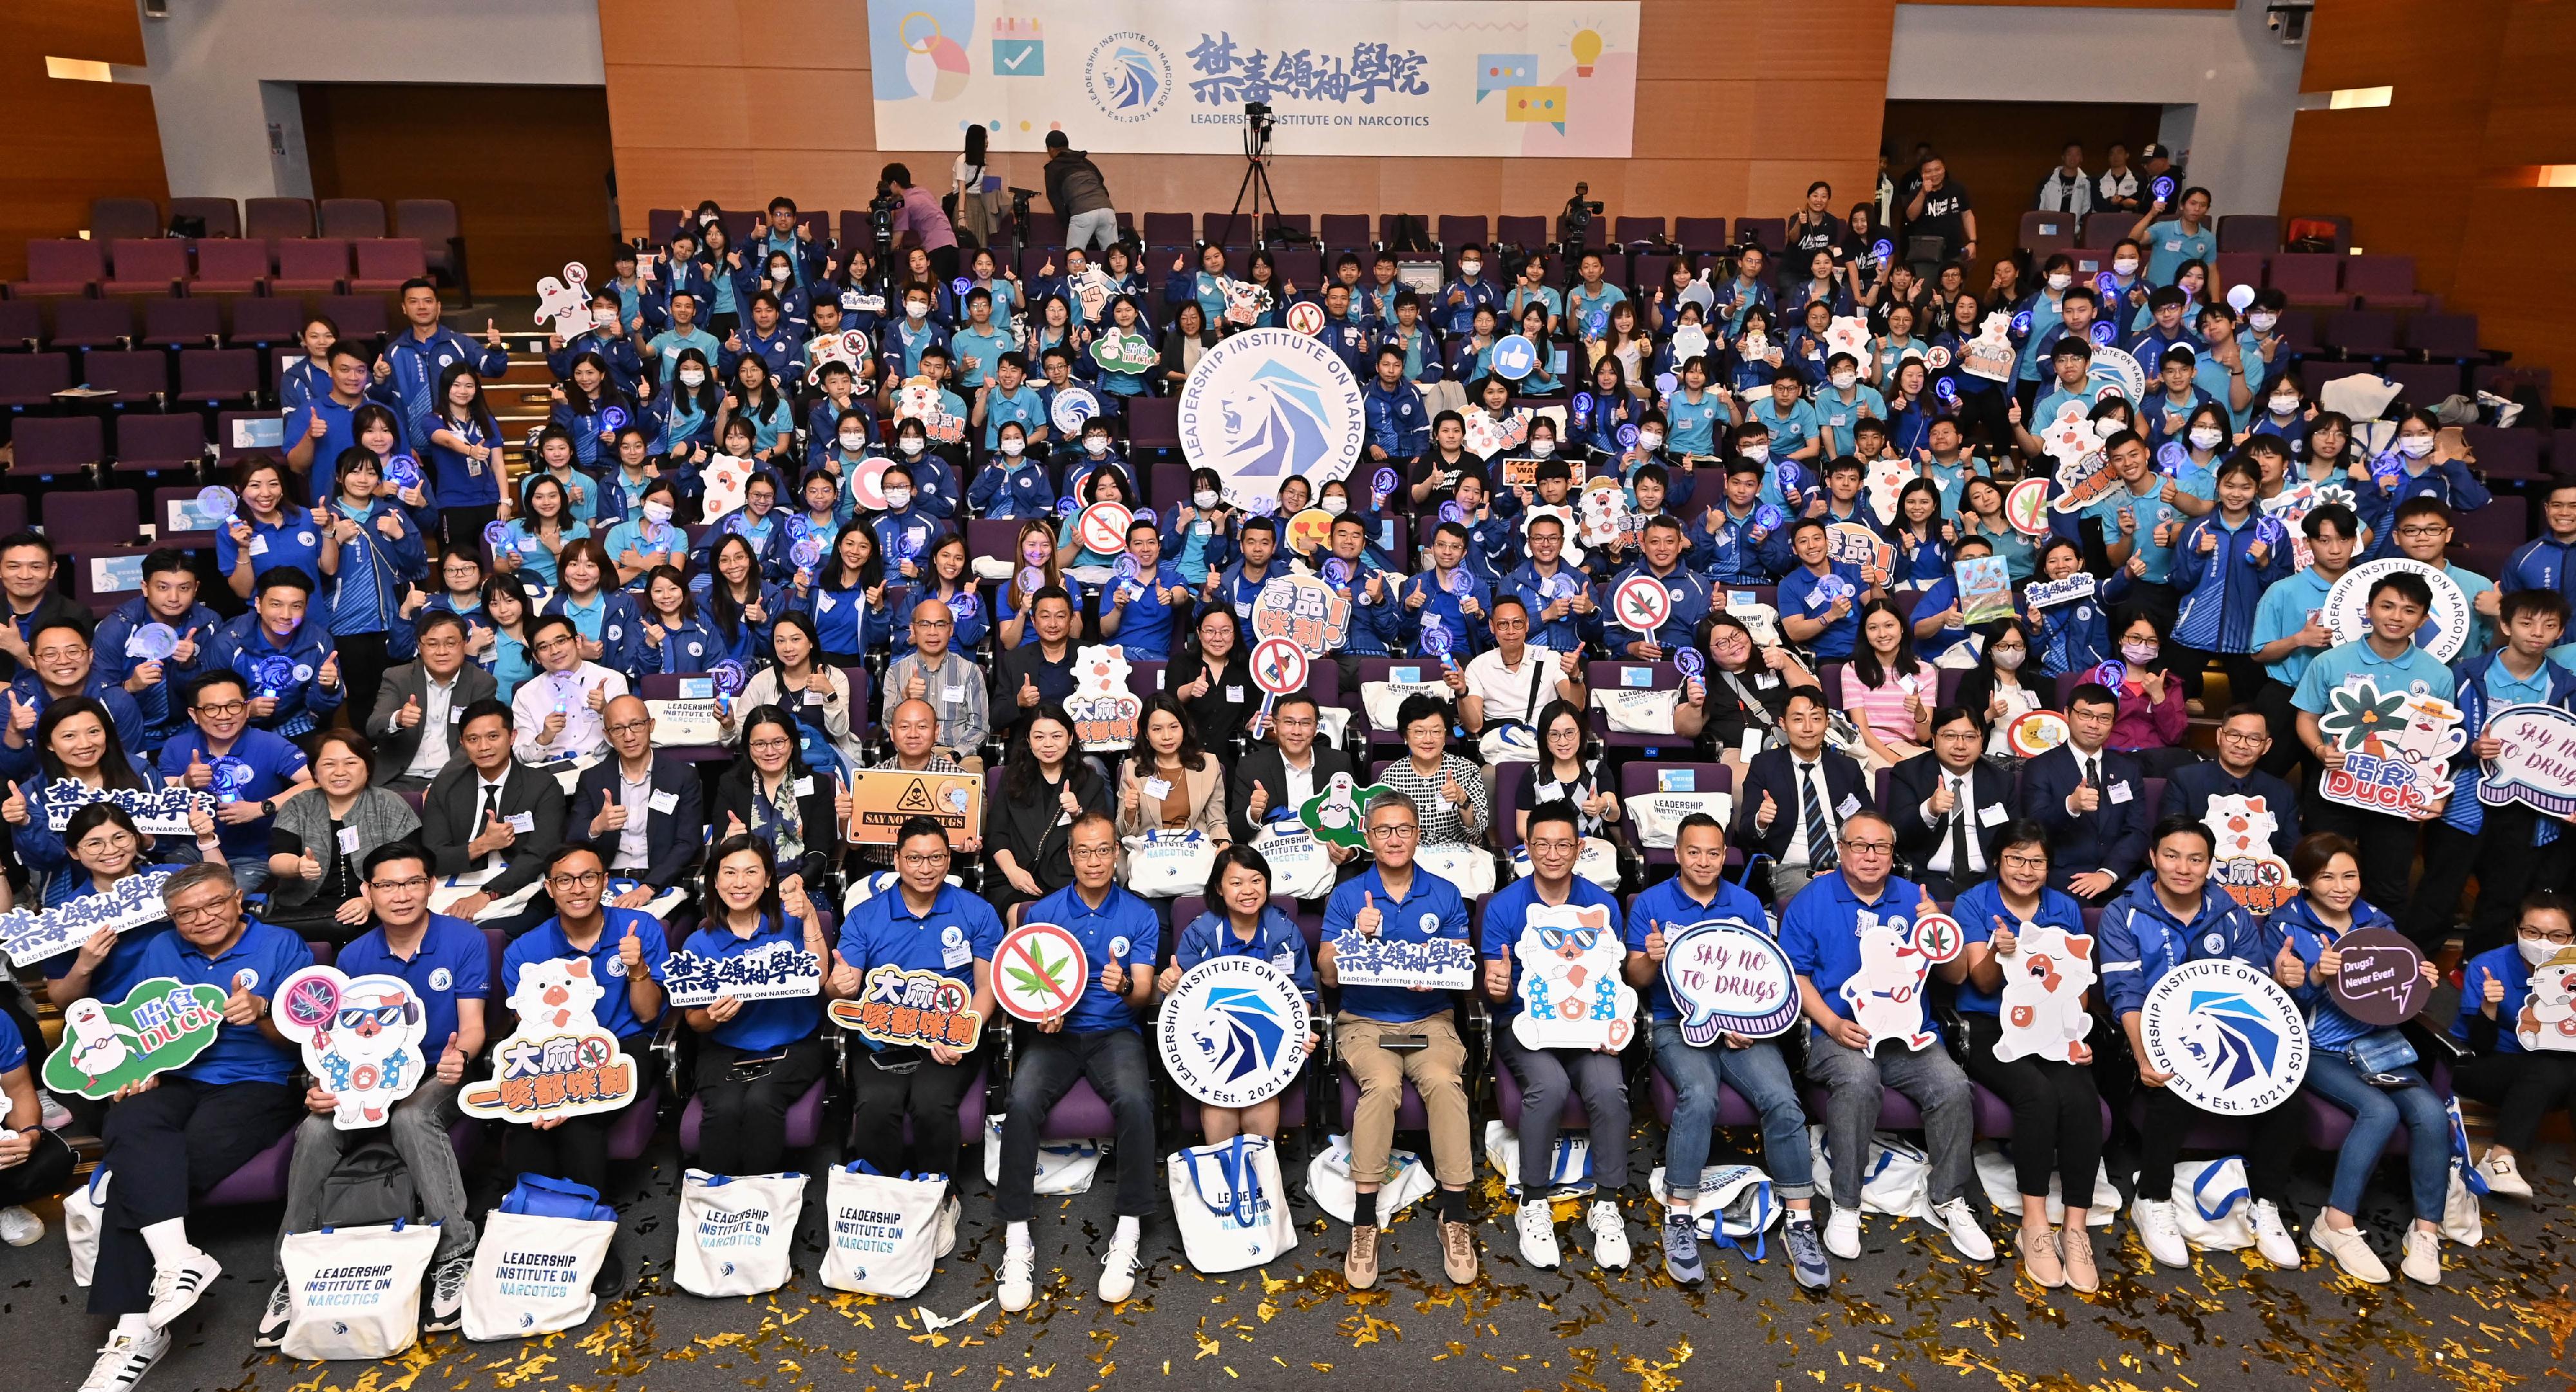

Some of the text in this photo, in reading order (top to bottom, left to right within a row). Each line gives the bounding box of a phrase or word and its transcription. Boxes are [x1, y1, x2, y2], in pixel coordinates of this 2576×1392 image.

[1085, 32, 1172, 107] LEADERSHIP INSTITUTE ON NARCOTICS
[1186, 30, 1430, 106] 禁毒領袖學院
[1334, 115, 1352, 125] ON
[1358, 115, 1430, 126] NARCOTICS
[1123, 353, 1151, 365] DUCK
[2121, 355, 2132, 365] ON
[2132, 366, 2143, 400] NARCOT
[1185, 333, 1362, 489] LEADERSHIP INSTITUTE ON NARCOTICS
[1264, 578, 1323, 616] 毒品
[2330, 562, 2465, 658] EADERSHIP INSTITUTE ON NARCOTICS
[1070, 697, 1116, 720] 大麻
[2515, 722, 2576, 760] SAY N
[2345, 755, 2415, 787] 唔食
[2499, 738, 2576, 787] TO DRUG
[2327, 769, 2421, 810] Duck
[1655, 800, 1703, 809] LEADERSHIP
[866, 813, 886, 824] SAY
[888, 814, 904, 825] NO
[935, 816, 963, 827] RUGS
[1147, 849, 1195, 858] NARCOTICS
[1258, 836, 1309, 850] LEADERSHIP
[1302, 844, 1314, 852] ON
[16, 943, 69, 964] LEADERSHIP
[111, 923, 125, 932] ON
[1335, 932, 1475, 975] 禁毒領袖學院
[1694, 944, 1770, 971] SAY NO
[2344, 956, 2374, 972] Drugs?
[663, 951, 820, 993] 禁毒領袖學院
[2345, 975, 2372, 988] Never
[673, 995, 717, 1004] LEADERSHIP
[769, 988, 810, 997] NARCOTICS
[869, 970, 938, 1009] 大麻
[1682, 970, 1779, 1004] TO DRUGS
[134, 988, 198, 1028] 唔食
[2157, 964, 2230, 1000] INSTITUTE
[2237, 969, 2259, 985] ON
[2264, 985, 2302, 1071] NARCOTICS
[140, 999, 222, 1052] DUCK
[835, 1002, 976, 1044] 一啖都咪制
[1166, 961, 1305, 1086] LEADERSHIP INSTITUTE ON NARCOTICS
[504, 1037, 578, 1079] 大麻
[468, 1064, 629, 1109] 一啖都咪制
[1214, 1077, 1282, 1102] Est. 2021
[2213, 1084, 2286, 1111] Est. 2021
[699, 1221, 770, 1236] INSTITUTE ON
[706, 1209, 769, 1223] LEADERSHIP
[840, 1207, 901, 1225] LEADERSHIP
[701, 1235, 762, 1248] NARCOTICS
[835, 1221, 903, 1239] INSTITUTE ON
[837, 1236, 894, 1253] NARCOTICS
[315, 1265, 392, 1279] LEADERSHIP
[503, 1252, 576, 1268] LEADERSHIP
[305, 1278, 392, 1292] INSTITUTE ON
[496, 1266, 577, 1283] INSTITUTE ON
[307, 1293, 380, 1306] NARCOTICS
[500, 1282, 567, 1297] NARCOTICS
